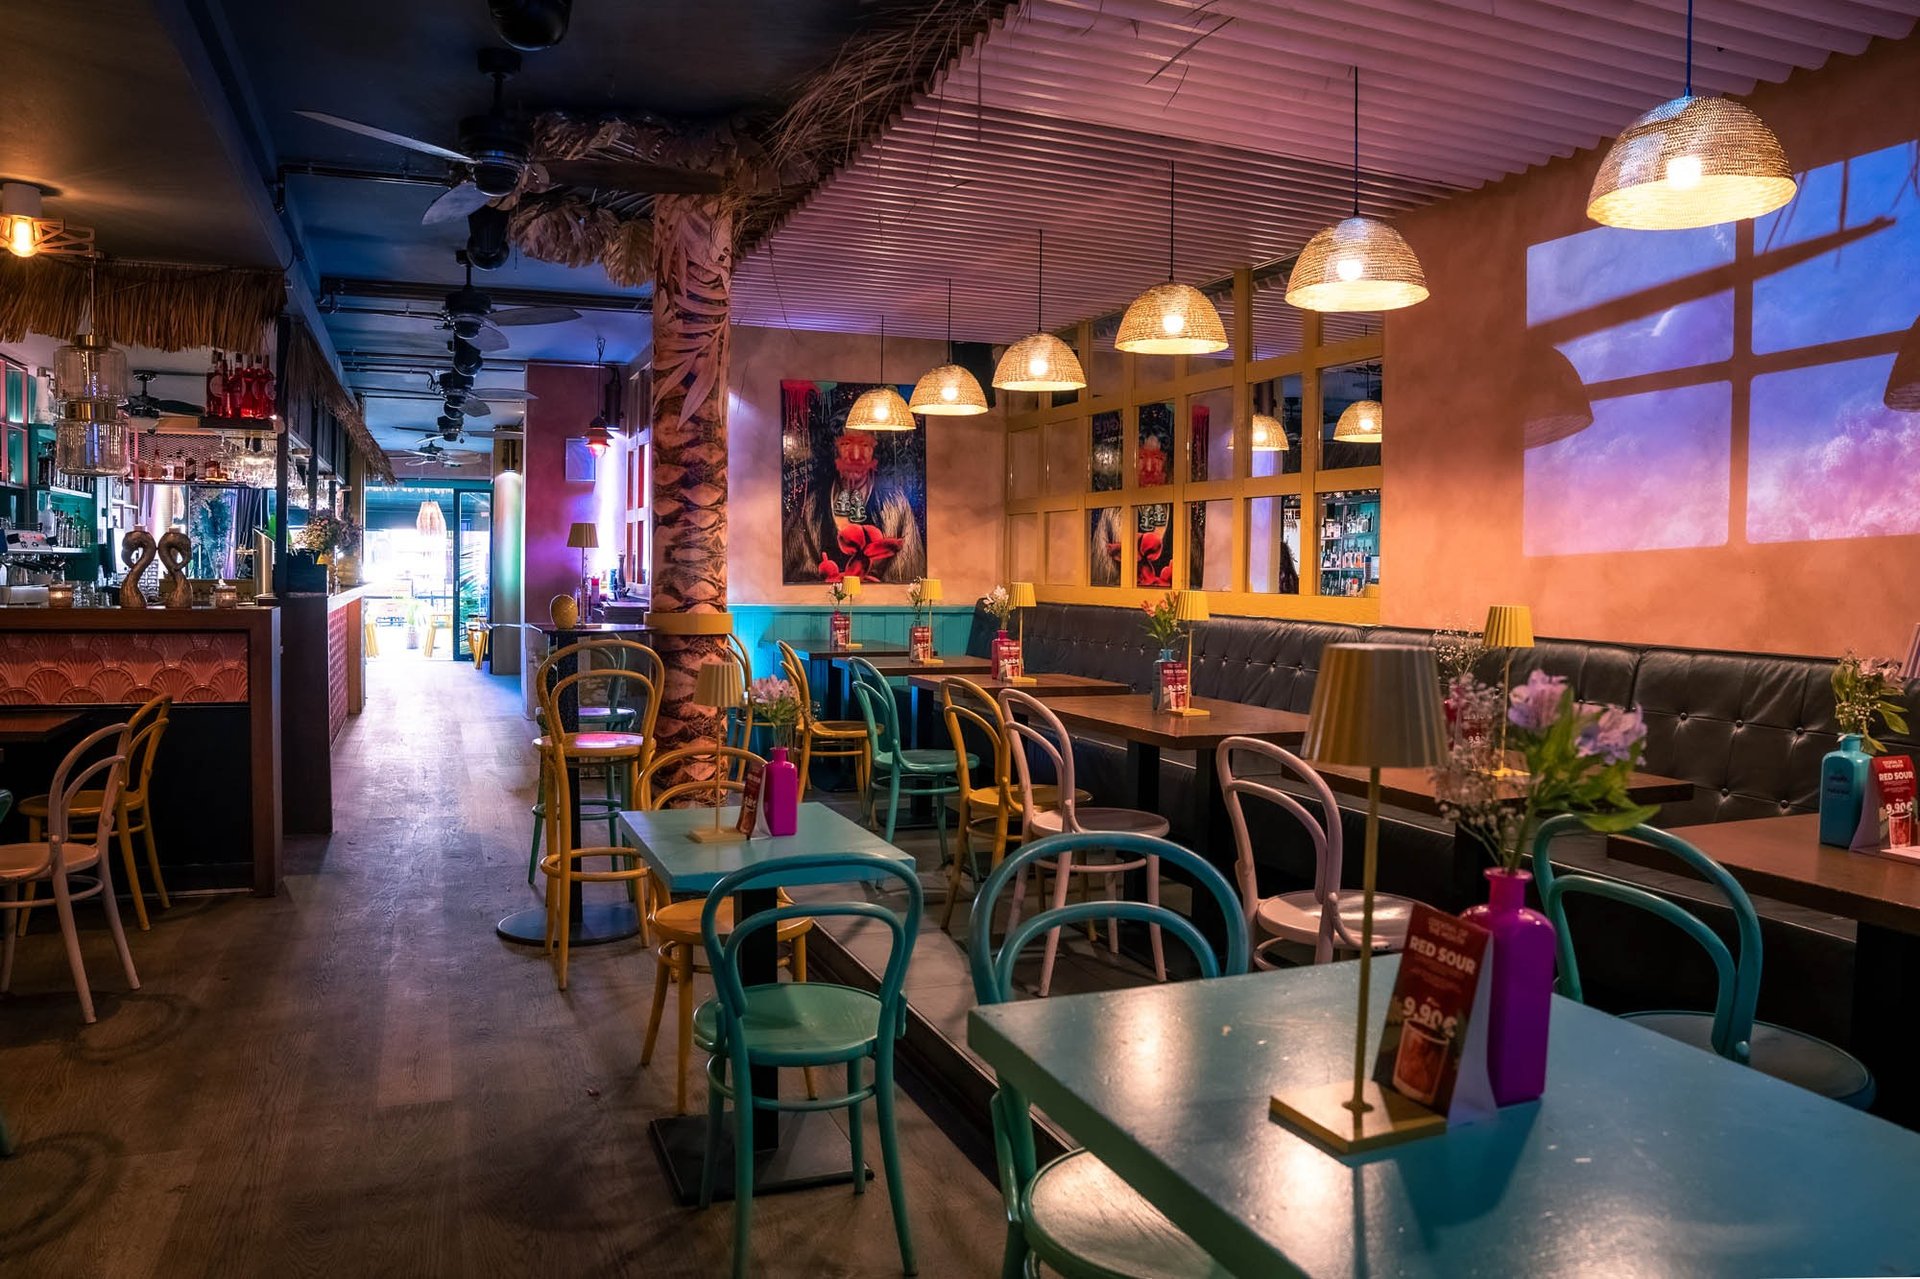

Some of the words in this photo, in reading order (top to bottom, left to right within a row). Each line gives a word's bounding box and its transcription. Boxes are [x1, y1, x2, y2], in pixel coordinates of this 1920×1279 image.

[1878, 773, 1893, 781] RED
[1894, 771, 1913, 780] SOUR
[1410, 936, 1435, 956] RED
[1437, 947, 1476, 974] SOUR
